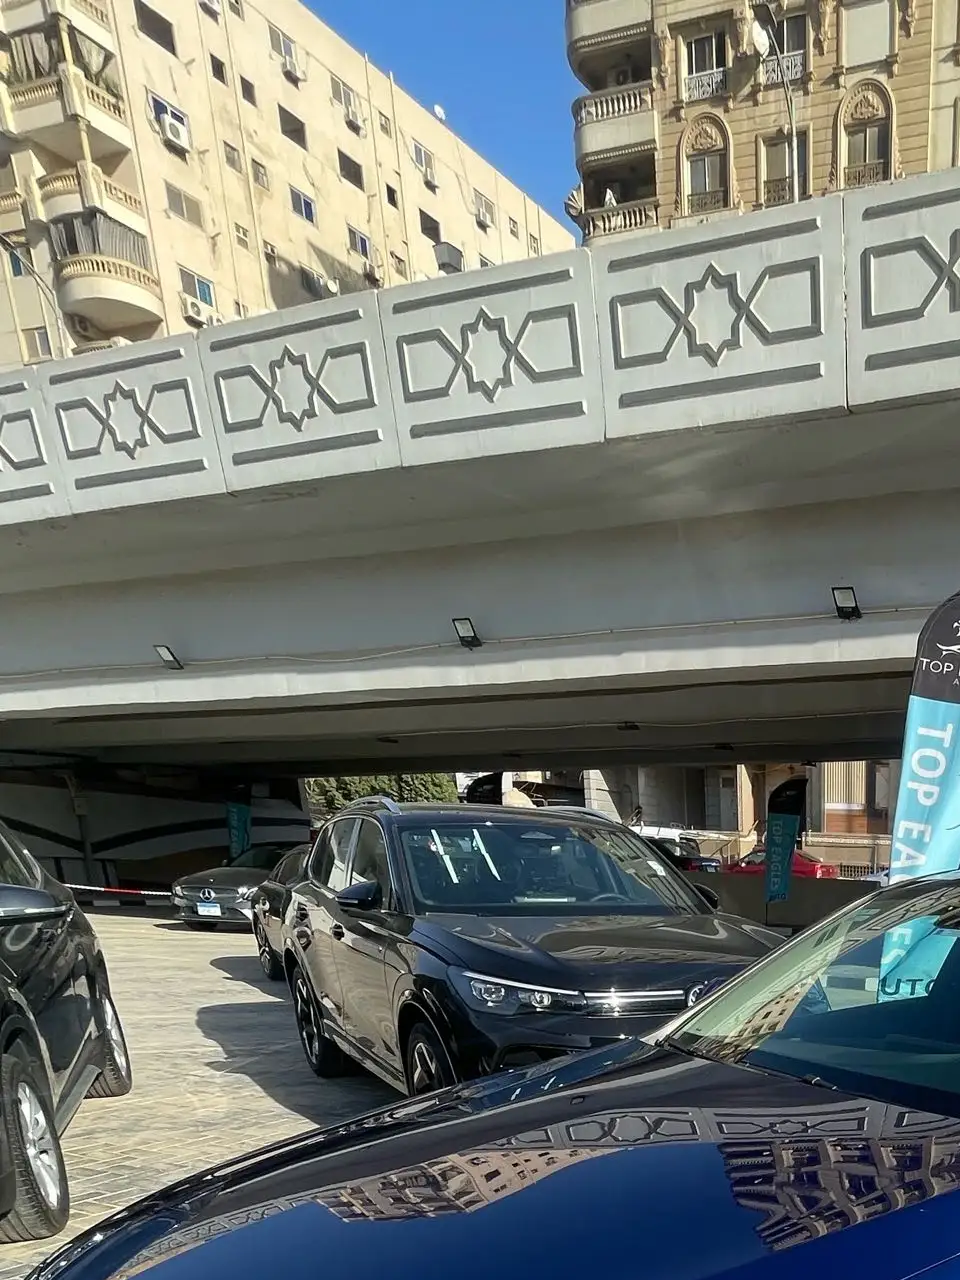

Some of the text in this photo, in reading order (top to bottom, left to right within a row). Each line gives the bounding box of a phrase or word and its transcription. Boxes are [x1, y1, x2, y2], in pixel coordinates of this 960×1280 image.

[920, 658, 954, 674] TOP
[907, 723, 954, 807] TOP
[770, 820, 783, 890] TOP EAGLES
